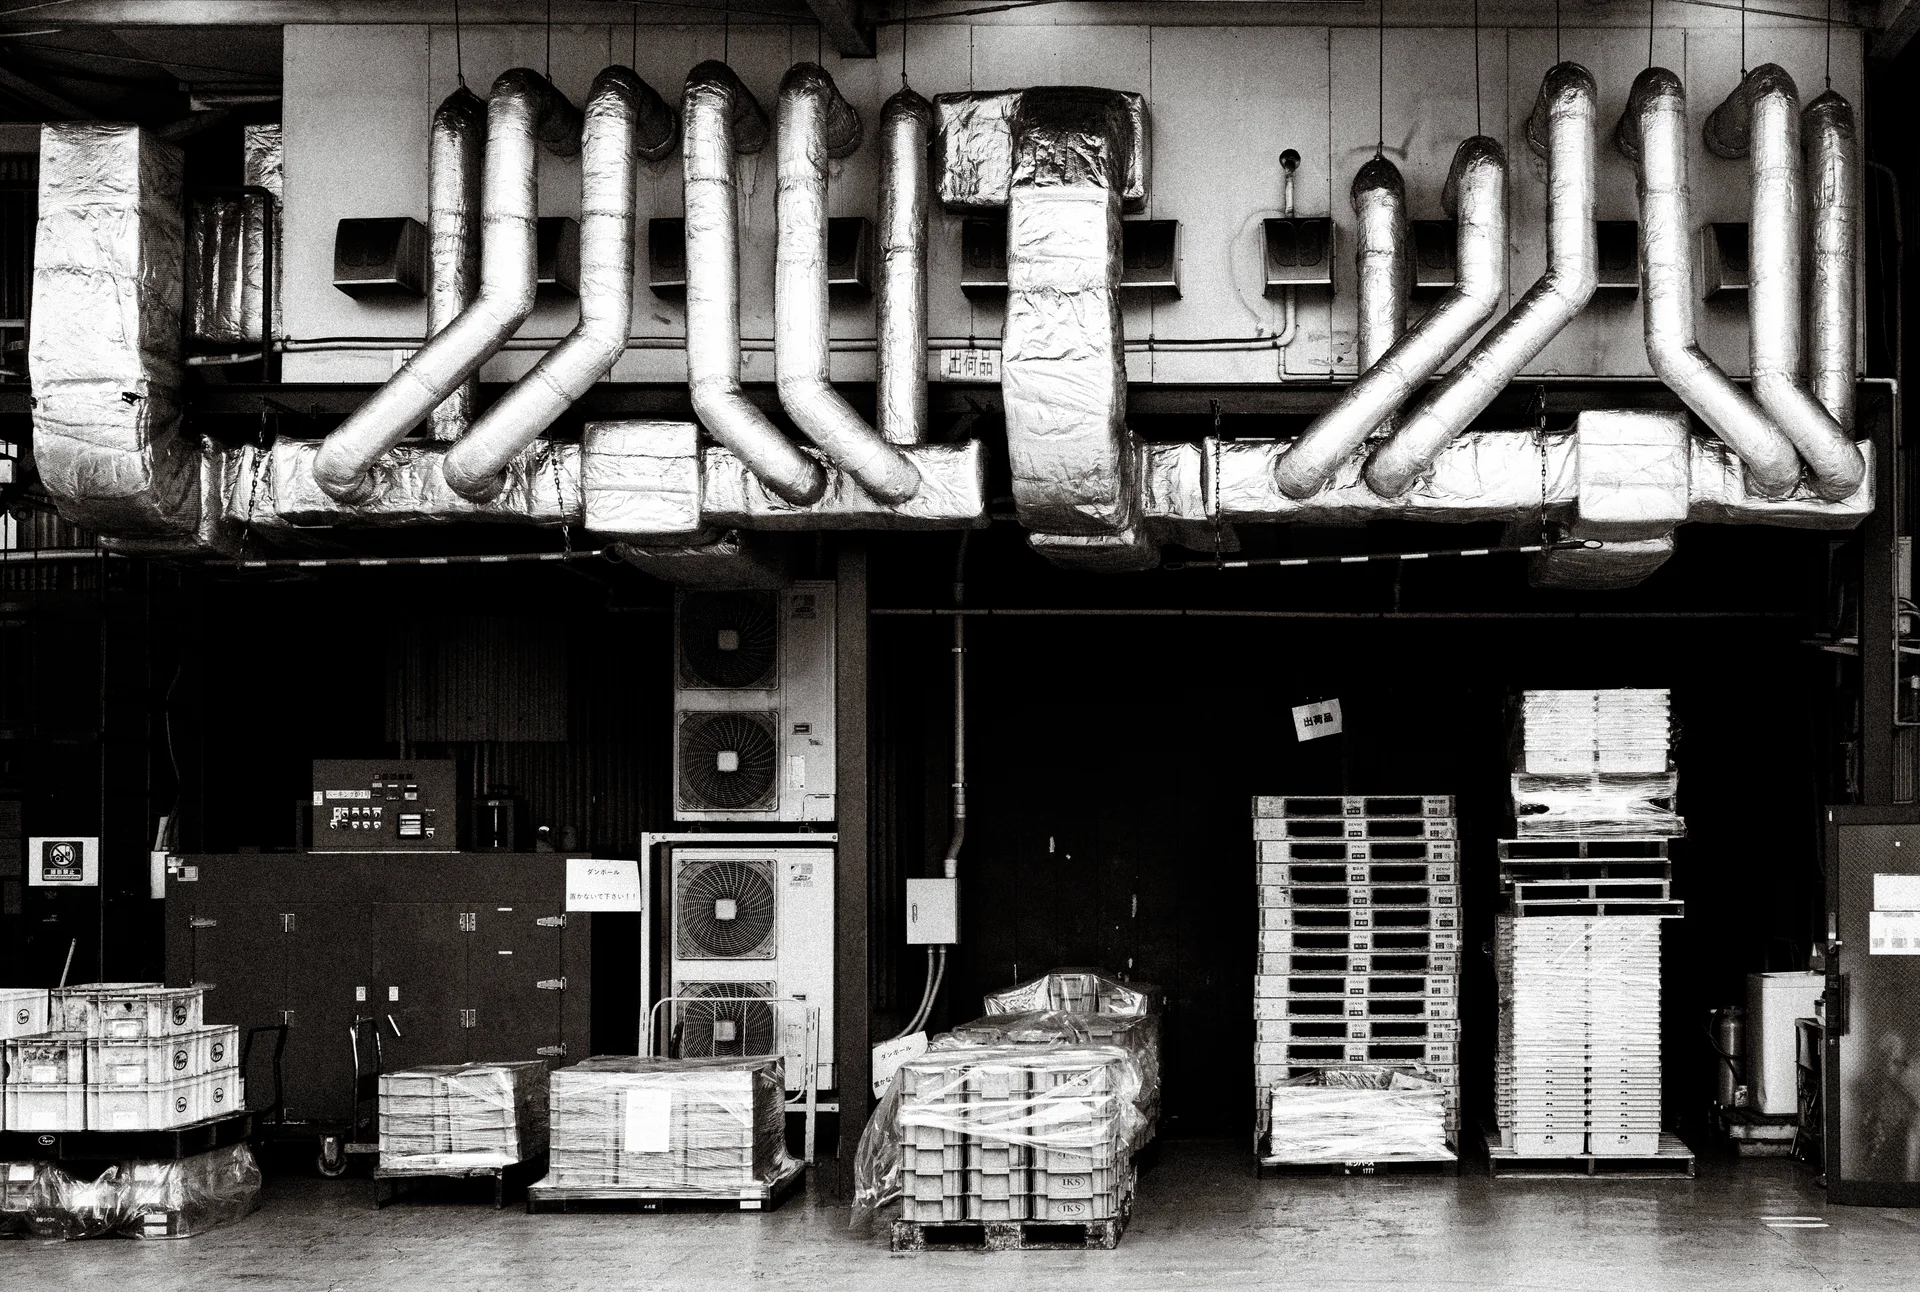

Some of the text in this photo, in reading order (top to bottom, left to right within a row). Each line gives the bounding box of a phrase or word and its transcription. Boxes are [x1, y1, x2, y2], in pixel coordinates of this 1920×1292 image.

[949, 349, 992, 376] 出荷品
[1303, 712, 1334, 727] 出荷品
[881, 1046, 912, 1060] ダンボール
[1063, 1178, 1081, 1186] IKS
